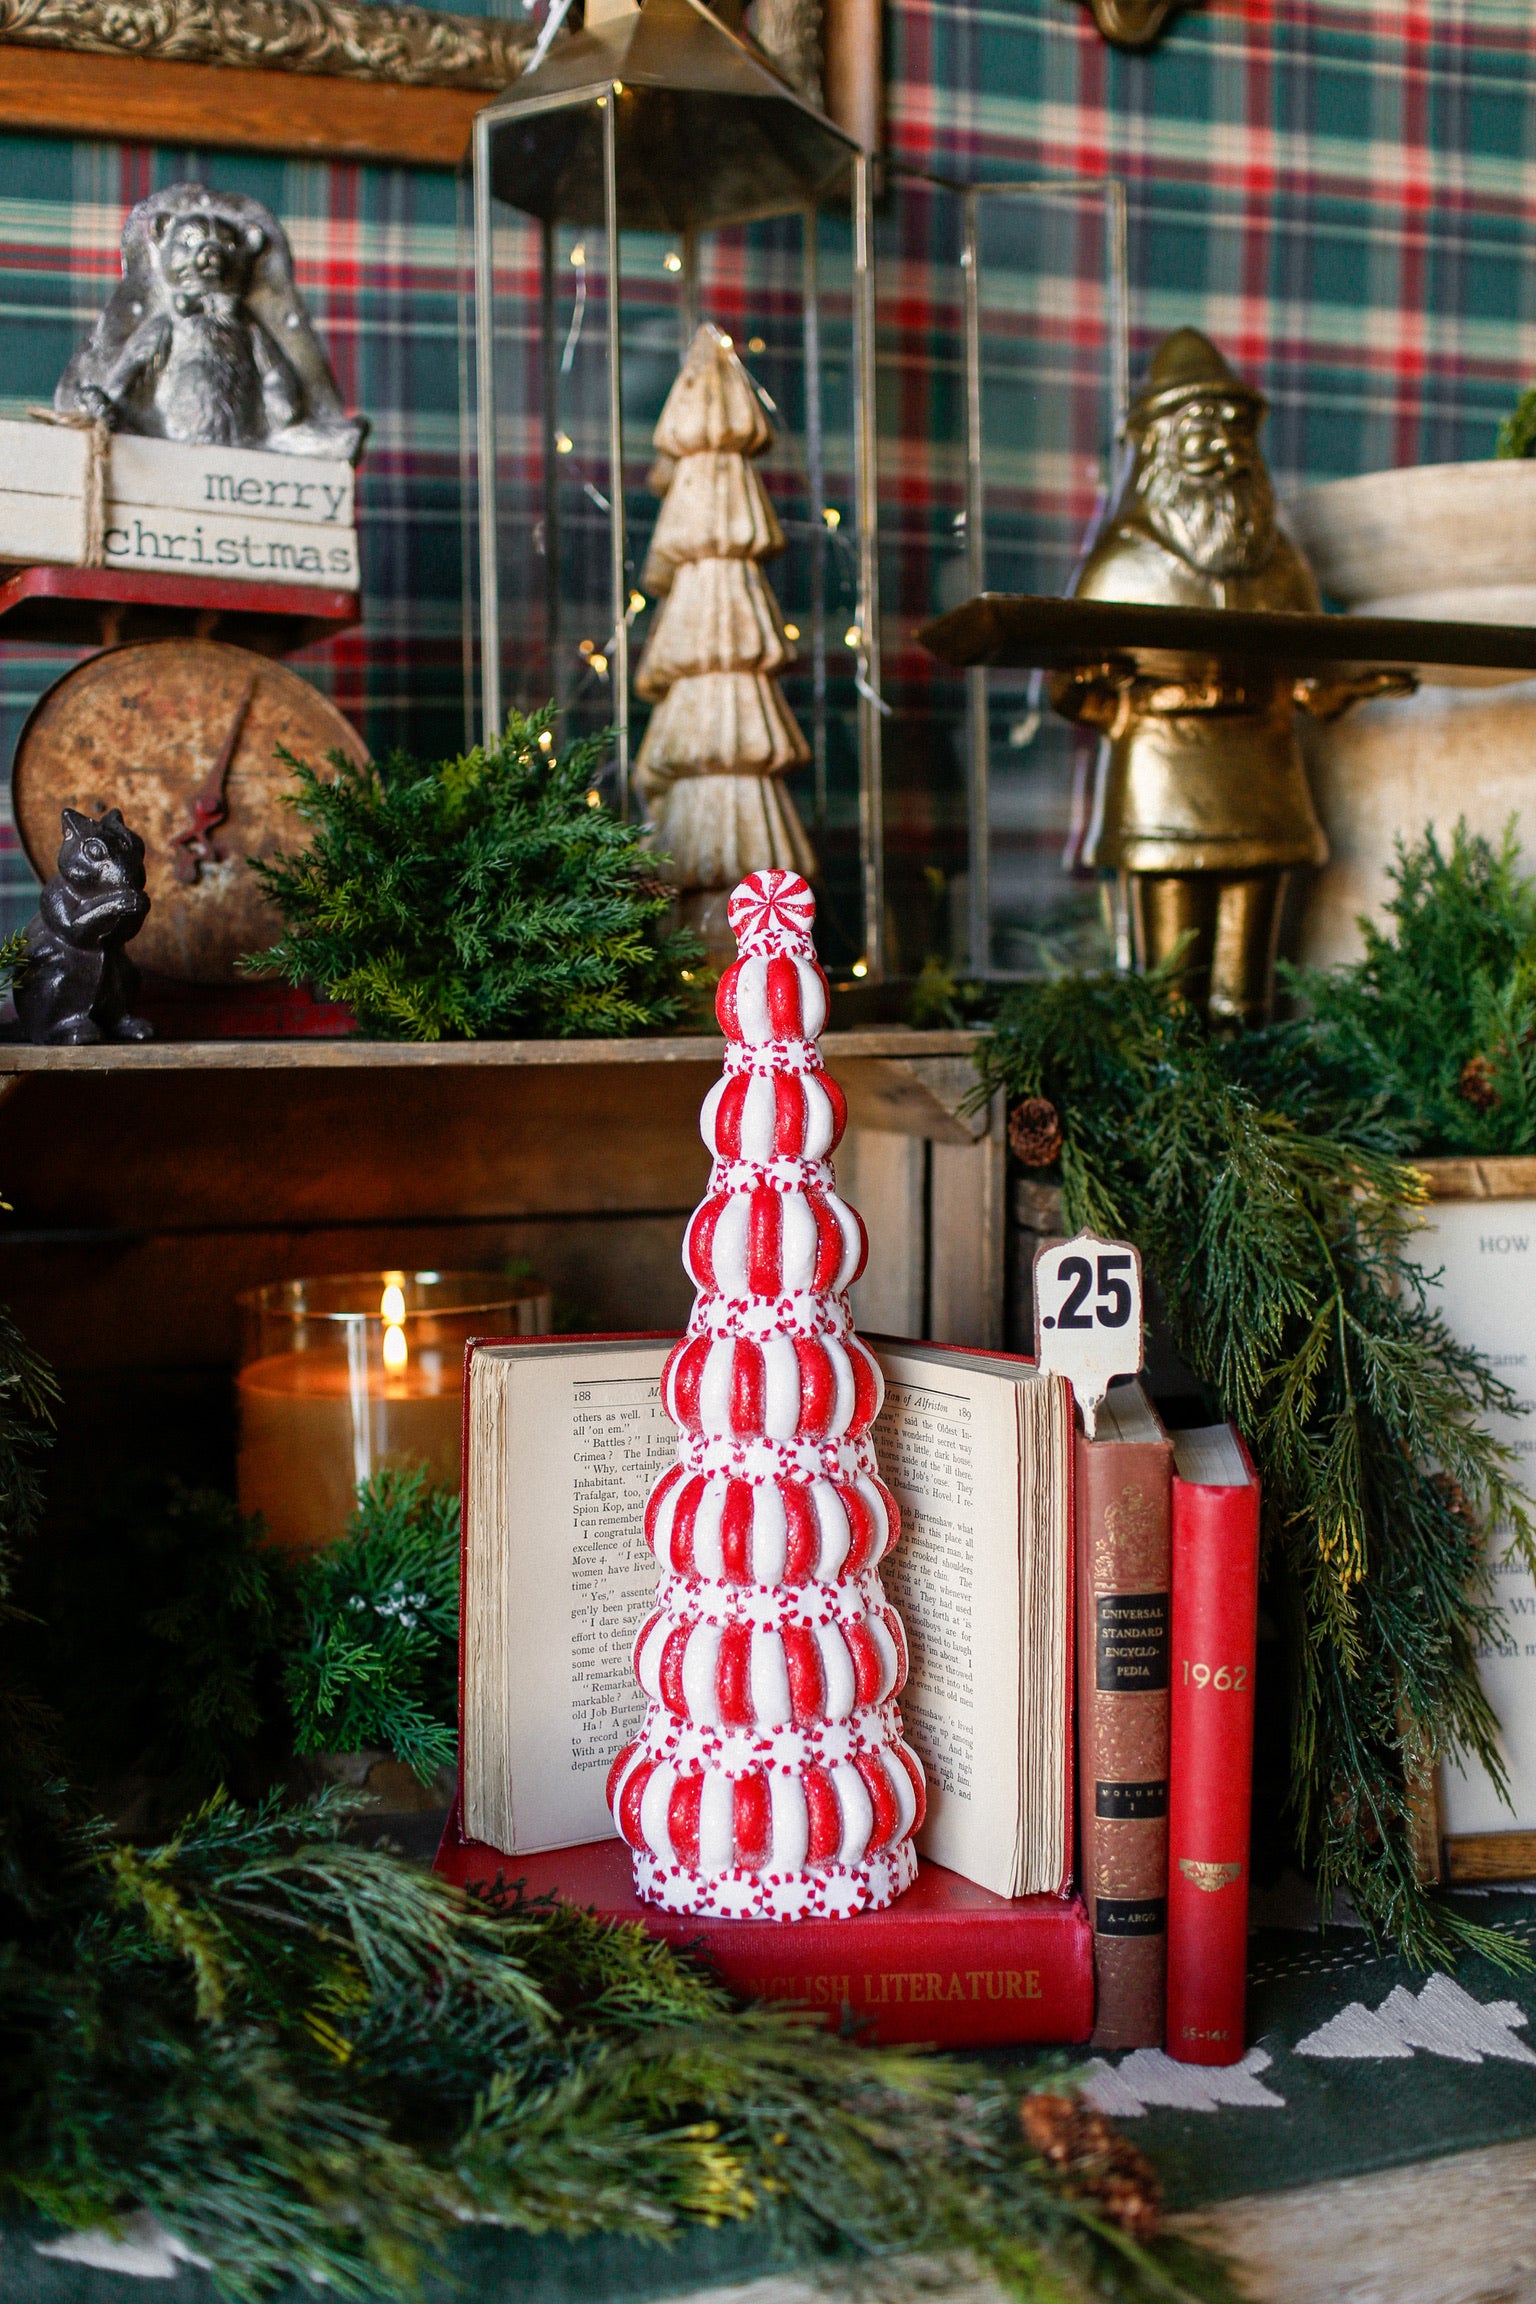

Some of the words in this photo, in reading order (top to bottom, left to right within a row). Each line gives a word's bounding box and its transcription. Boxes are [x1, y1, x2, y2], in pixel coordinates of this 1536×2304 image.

[205, 473, 347, 520] merry
[104, 521, 350, 573] christmas
[1480, 1235, 1530, 1253] HOW
[1042, 1255, 1131, 1329] .25
[574, 1391, 591, 1401] 188
[914, 1397, 948, 1412] Alfriston
[573, 1412, 602, 1422] others
[620, 1410, 640, 1419] well.
[937, 1423, 957, 1436] Oldest
[902, 1430, 934, 1443] wonderful
[937, 1438, 955, 1449] secret
[959, 1443, 972, 1455] way
[624, 1449, 640, 1458] The
[647, 1448, 676, 1456] Indian
[914, 1444, 931, 1456] little,
[935, 1449, 949, 1460] dark
[953, 1453, 973, 1468] house,
[622, 1461, 663, 1472] certainly,
[902, 1456, 918, 1465] aside
[574, 1477, 625, 1488] Inhabitant.
[912, 1469, 929, 1481] Job's
[957, 1481, 973, 1496] They
[573, 1490, 618, 1501] Trafalgar,
[624, 1489, 640, 1497] too,
[933, 1488, 953, 1504] Hovel,
[573, 1505, 599, 1516] Spion
[603, 1503, 624, 1513] Kop,
[627, 1501, 644, 1510] and
[581, 1518, 596, 1526] can
[599, 1515, 643, 1525] remember
[914, 1509, 954, 1529] Burtenshaw,
[957, 1523, 973, 1534] what
[945, 1532, 961, 1544] place
[573, 1542, 617, 1552] excellence
[911, 1537, 944, 1553] misshapen
[572, 1556, 596, 1565] Move
[899, 1561, 917, 1571] under
[912, 1550, 938, 1564] crooked
[942, 1559, 973, 1575] shoulders
[572, 1569, 603, 1577] women
[608, 1565, 629, 1574] have
[634, 1561, 655, 1571] lived
[898, 1571, 911, 1583] look
[940, 1583, 972, 1600] whenever
[603, 1604, 623, 1613] been
[920, 1591, 936, 1606] They
[956, 1605, 972, 1615] used
[933, 1610, 949, 1621] forth
[1102, 1608, 1163, 1619] UNIVERSAL
[599, 1617, 617, 1626] dare
[571, 1633, 596, 1642] effort
[611, 1628, 637, 1638] define
[1102, 1627, 1163, 1638] STANDARD
[572, 1646, 595, 1655] some
[927, 1633, 942, 1645] used
[953, 1642, 972, 1656] laugh
[1105, 1646, 1160, 1657] ENCYCLO-
[572, 1659, 595, 1669] some
[601, 1656, 622, 1664] were
[928, 1660, 943, 1670] once
[946, 1665, 973, 1681] throwed
[1117, 1666, 1150, 1676] PEDIA
[1183, 1660, 1248, 1691] 1962
[929, 1671, 944, 1683] went
[947, 1677, 960, 1688] into
[572, 1710, 587, 1720] old
[591, 1709, 607, 1719] Job
[623, 1715, 640, 1728] goal
[958, 1721, 973, 1735] lived
[590, 1732, 617, 1743] record
[912, 1716, 936, 1734] cottage
[952, 1732, 973, 1750] among
[572, 1746, 594, 1757] With
[949, 1744, 962, 1757] And
[938, 1752, 953, 1763] went
[959, 1762, 972, 1775] nigh
[940, 1767, 954, 1779] nigh
[943, 1780, 956, 1794] Job,
[1102, 1788, 1164, 1797] VOLUME
[863, 1970, 1042, 2003] LITERATURE
